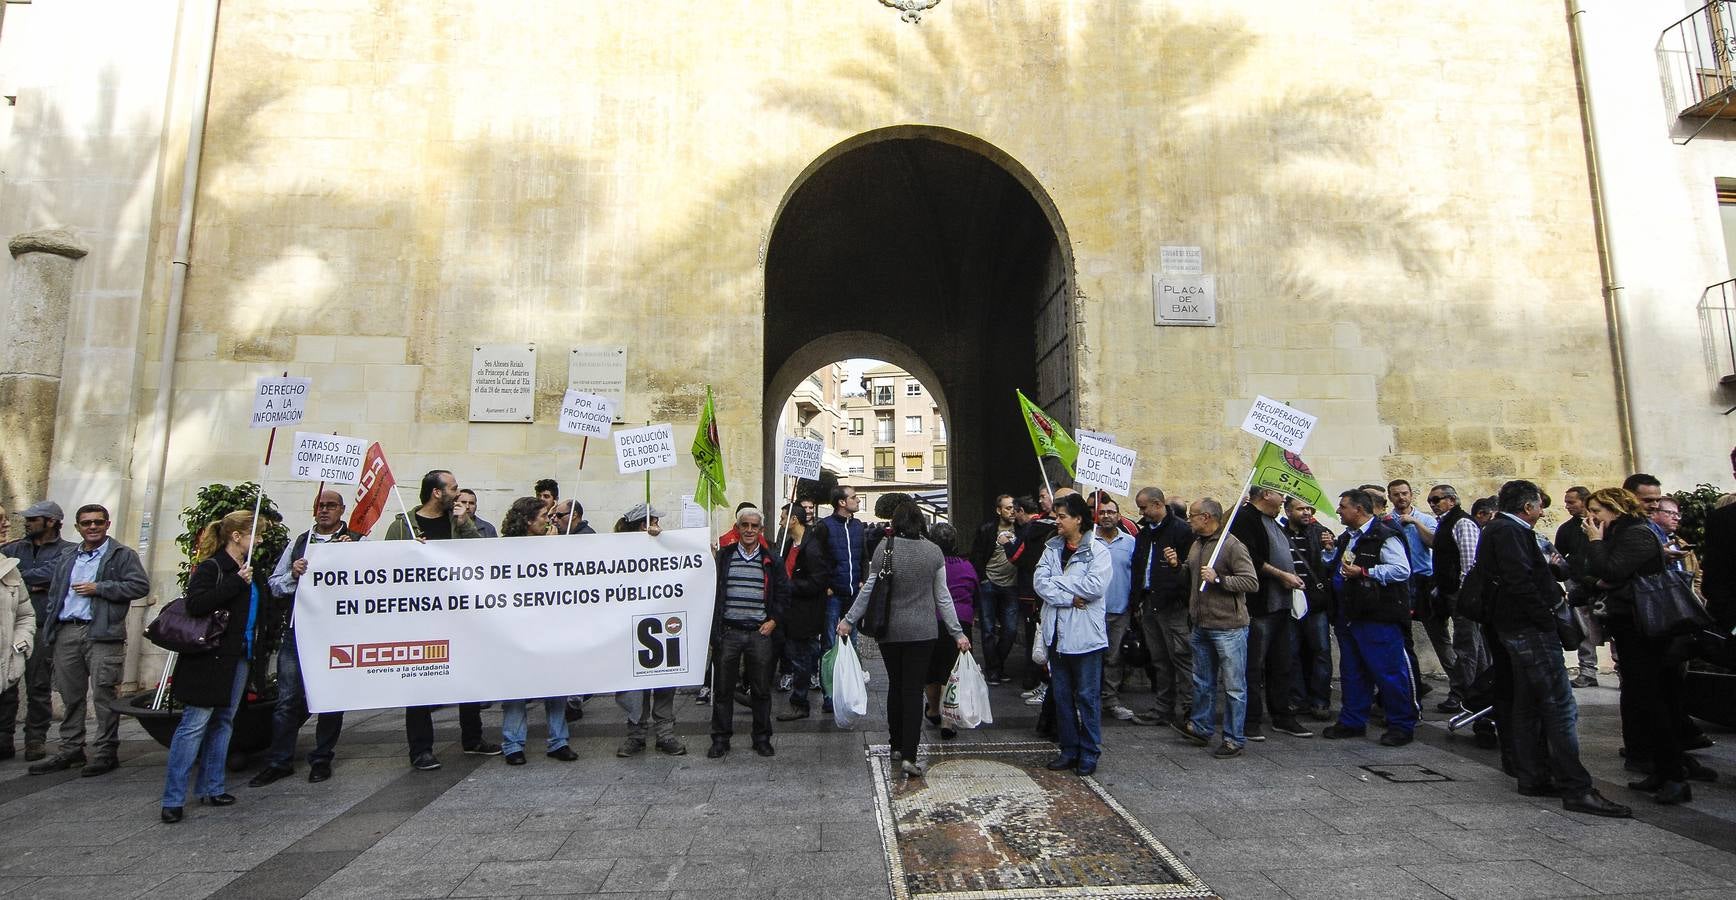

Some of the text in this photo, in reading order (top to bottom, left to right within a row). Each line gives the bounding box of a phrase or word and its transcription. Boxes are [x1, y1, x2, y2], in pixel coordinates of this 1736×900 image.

[1172, 304, 1199, 313] BAIX
[260, 384, 305, 396] DERECHO
[265, 398, 292, 409] A LA
[575, 398, 606, 411] POR LA
[253, 408, 302, 423] INFORMACIÓN
[563, 407, 612, 424] PROMOCIÓN
[1255, 400, 1312, 430] RECUPERACIÓN
[568, 421, 601, 434] INTERNA
[1251, 410, 1305, 440] PRESTACIONES
[620, 428, 669, 446] DEVOLUCIÓN
[1252, 423, 1294, 447] SOCIALES
[300, 439, 362, 456] ATRASOS DEL
[622, 442, 670, 458] DEL ROBO AL
[786, 440, 813, 451] EJECUCIÓN
[298, 451, 360, 468] COMPLEMENTO
[624, 456, 656, 469] GRUPO
[1080, 442, 1134, 467] RECUPERACIÓN
[784, 456, 820, 470] COMPLEMENTO
[794, 466, 816, 476] DESTINO
[1087, 458, 1120, 477] DE LA
[298, 466, 355, 481] DE DESTINO
[1078, 468, 1128, 490] PRODUCTIVIDAD
[313, 554, 703, 587] POR LOS DERECHOS DE LOS TRABAJADORES/AS
[336, 583, 684, 616] EN DEFENSA DE LOS SERVICIOS PÚBLICOS
[412, 664, 450, 672] ciutadania
